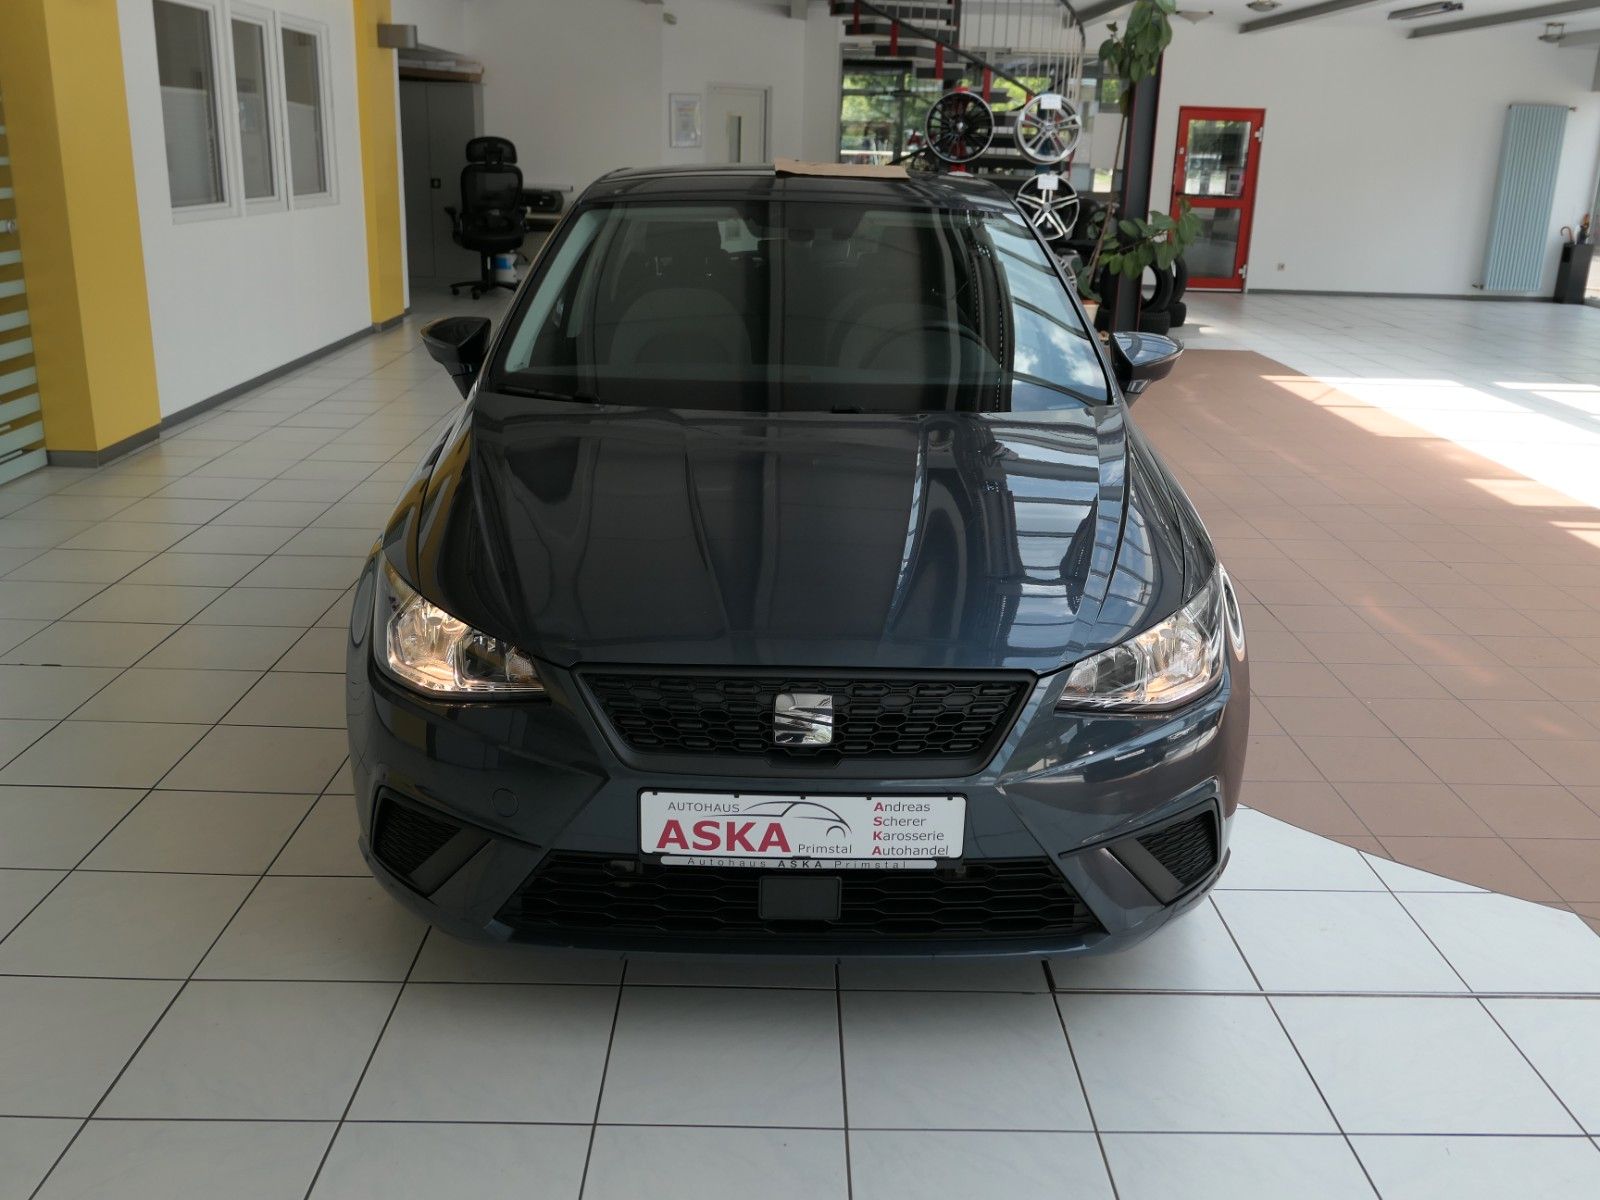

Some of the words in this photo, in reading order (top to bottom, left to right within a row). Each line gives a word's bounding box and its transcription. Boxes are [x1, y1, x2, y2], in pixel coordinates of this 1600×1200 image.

[667, 801, 740, 814] AUTOHAUS
[873, 801, 931, 812] Andreas
[873, 816, 927, 827] Scherer
[656, 819, 791, 853] ASKA
[873, 831, 945, 842] Karosserie
[798, 844, 852, 855] Primstal
[872, 845, 950, 857] Autohandel
[687, 857, 767, 868] Autohaus
[777, 860, 823, 869] ASKA
[834, 861, 907, 870] Primstal
